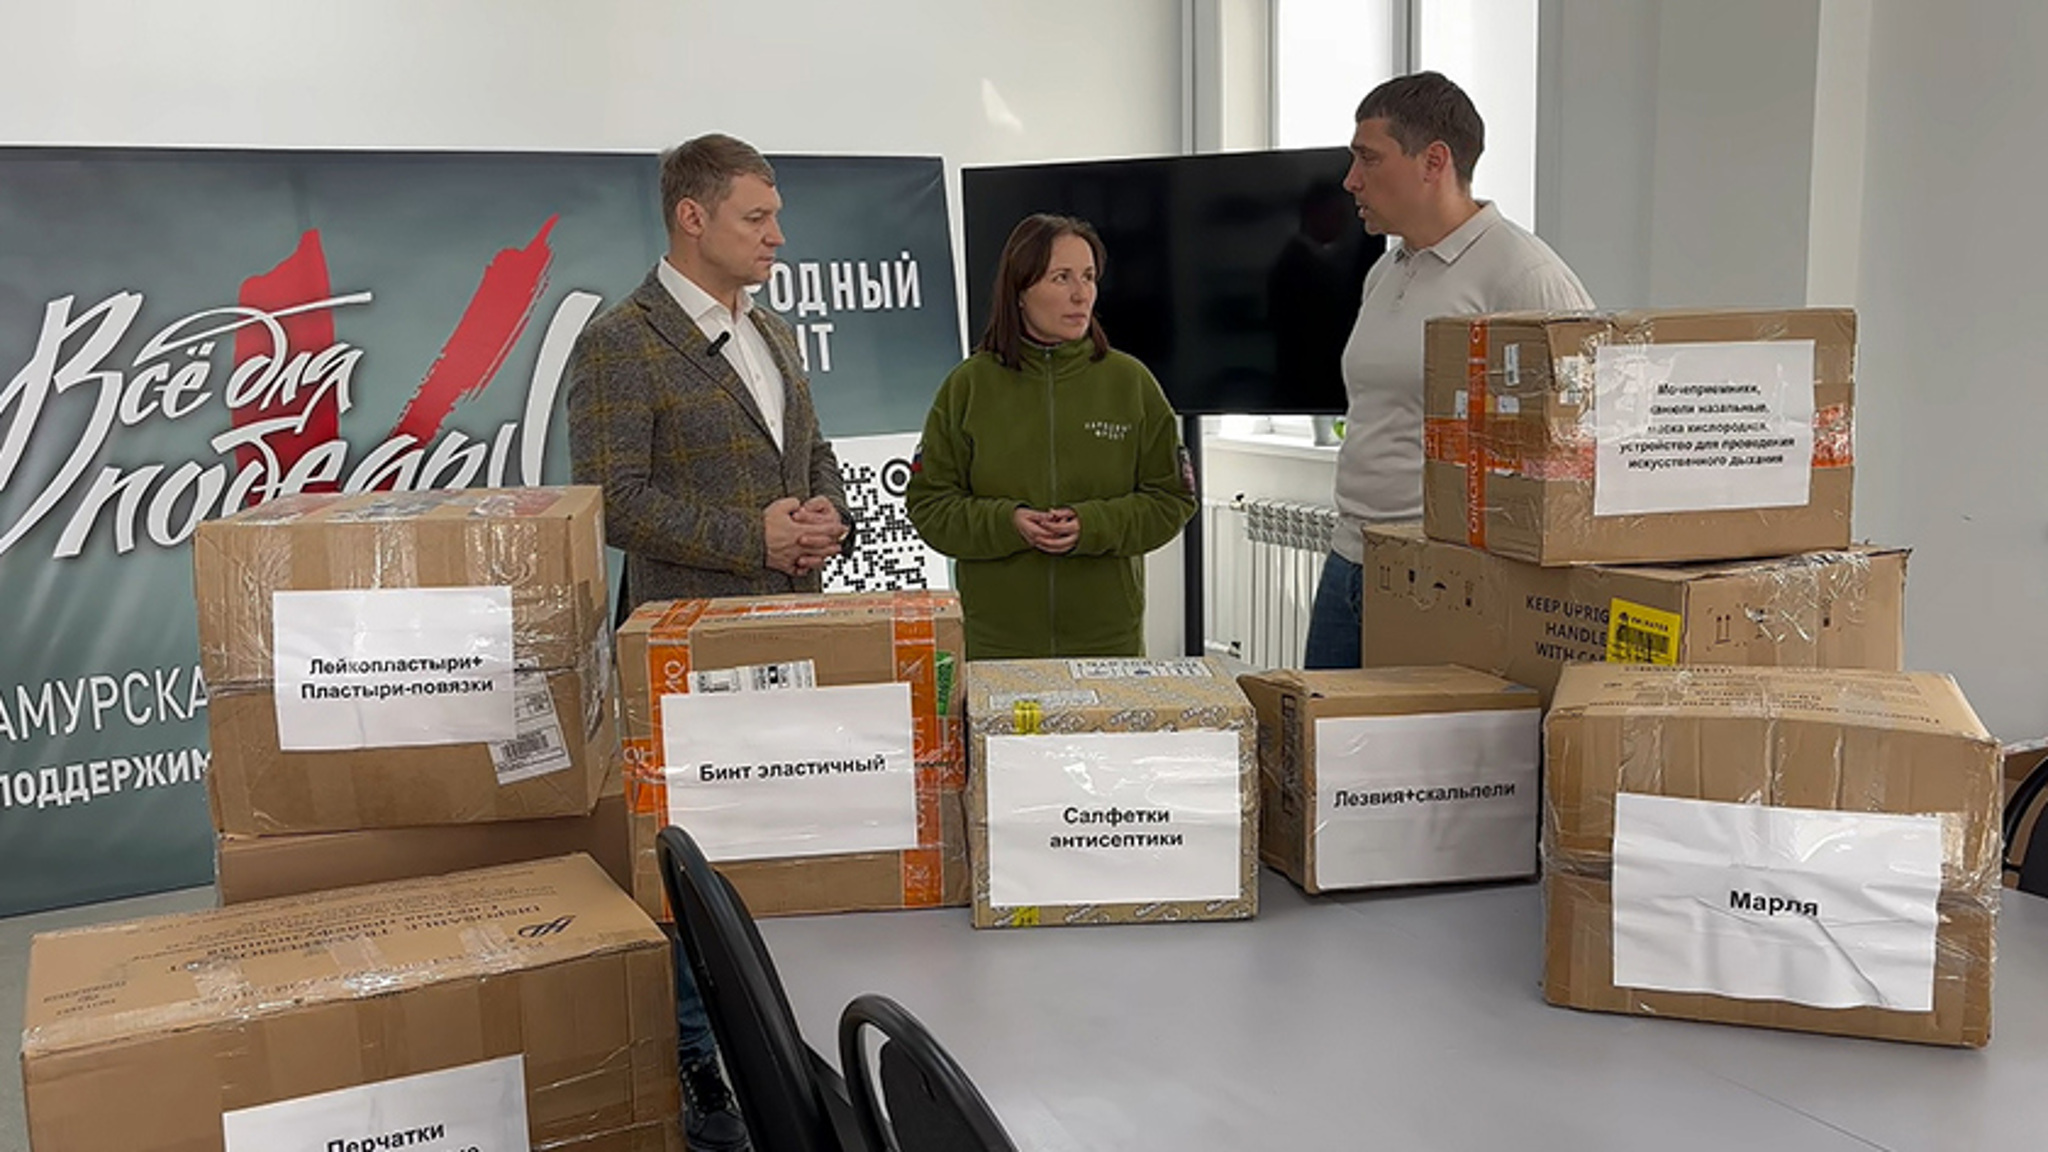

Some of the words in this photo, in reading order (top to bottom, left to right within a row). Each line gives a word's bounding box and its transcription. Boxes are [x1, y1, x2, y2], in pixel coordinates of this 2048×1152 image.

[745, 250, 922, 318] ОДНЫЙ
[1526, 594, 1561, 614] KEEP
[1564, 602, 1609, 625] UPRIG
[309, 655, 484, 677] Лейкопластыри+
[301, 679, 494, 701] Пластыри-повязки
[699, 763, 753, 783] Бинт
[757, 753, 887, 780] эластичный
[1333, 781, 1517, 810] Лезвия+скальпели
[1063, 805, 1170, 828] Салфетки
[1049, 827, 1184, 850] антисептики
[1729, 889, 1819, 918] Марля
[326, 1123, 446, 1152] Перчатки
